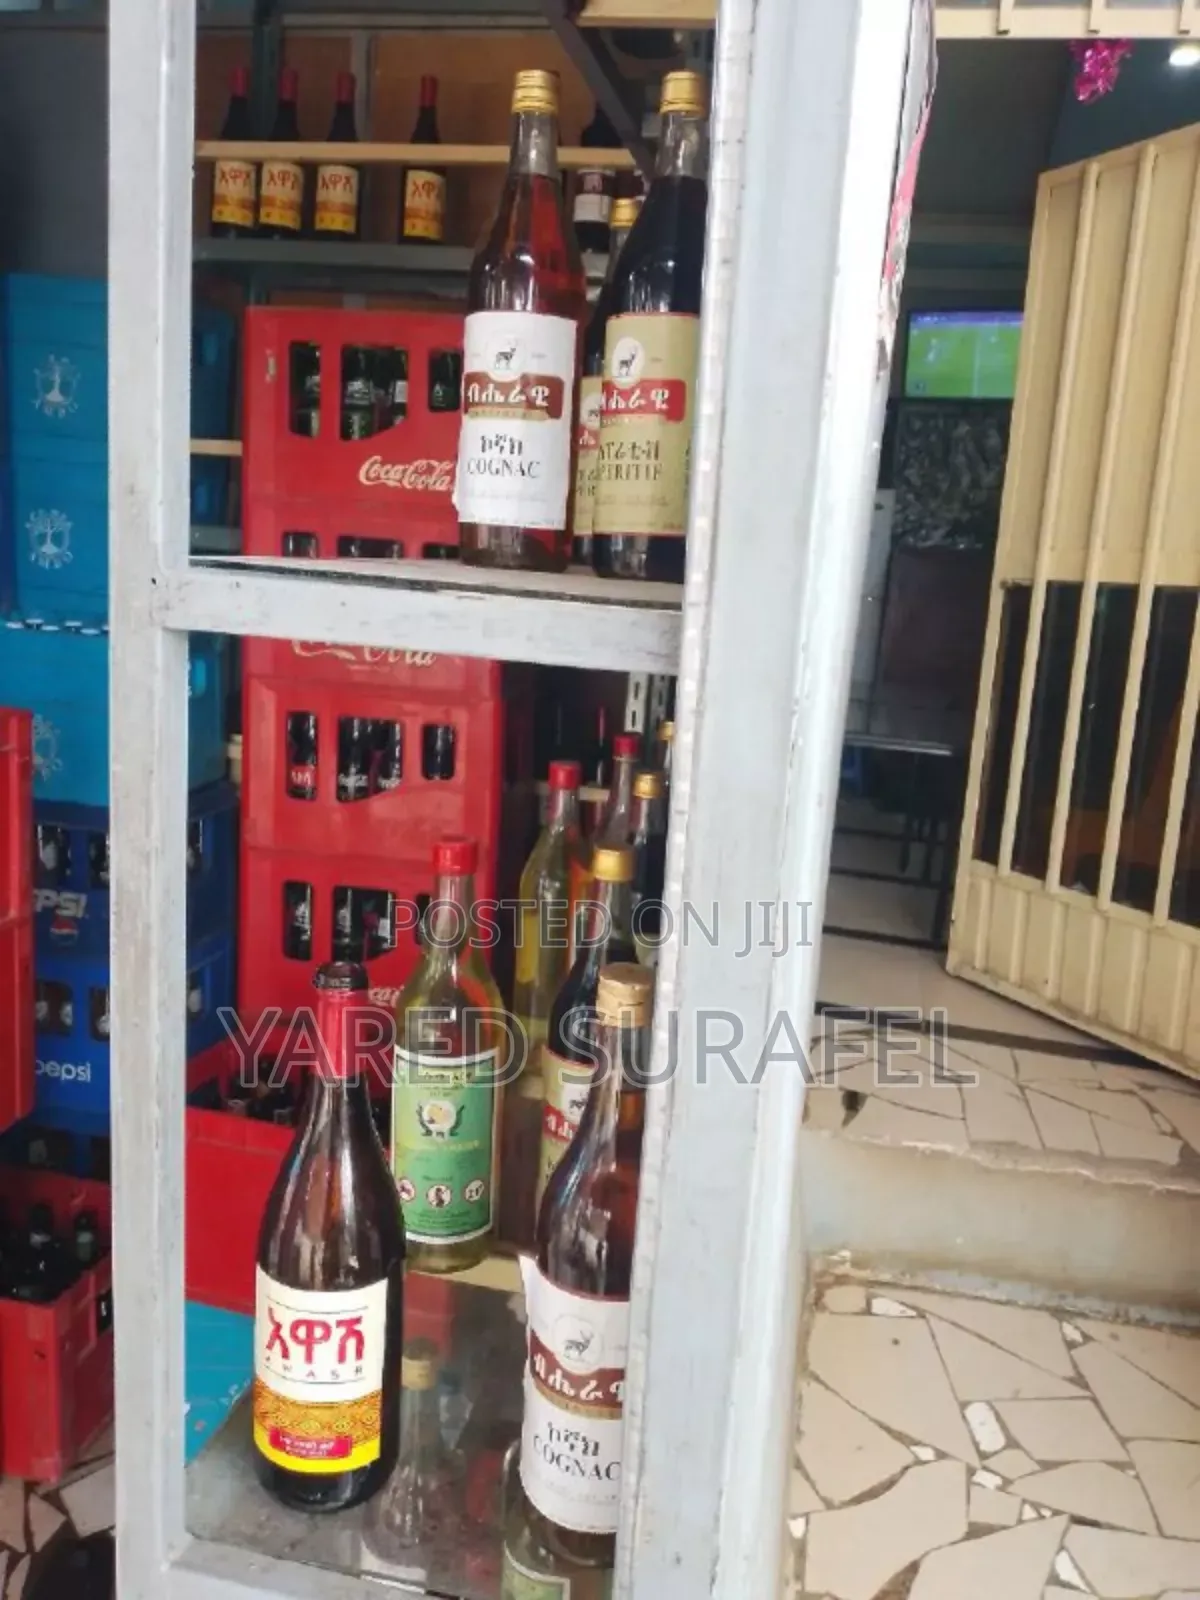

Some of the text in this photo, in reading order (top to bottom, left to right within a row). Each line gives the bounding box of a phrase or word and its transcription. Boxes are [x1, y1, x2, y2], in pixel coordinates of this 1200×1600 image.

[466, 458, 541, 479] COGNAC
[34, 887, 88, 918] PSI
[265, 1305, 365, 1365] አዋሽ
[533, 1435, 622, 1482] COGNAC
